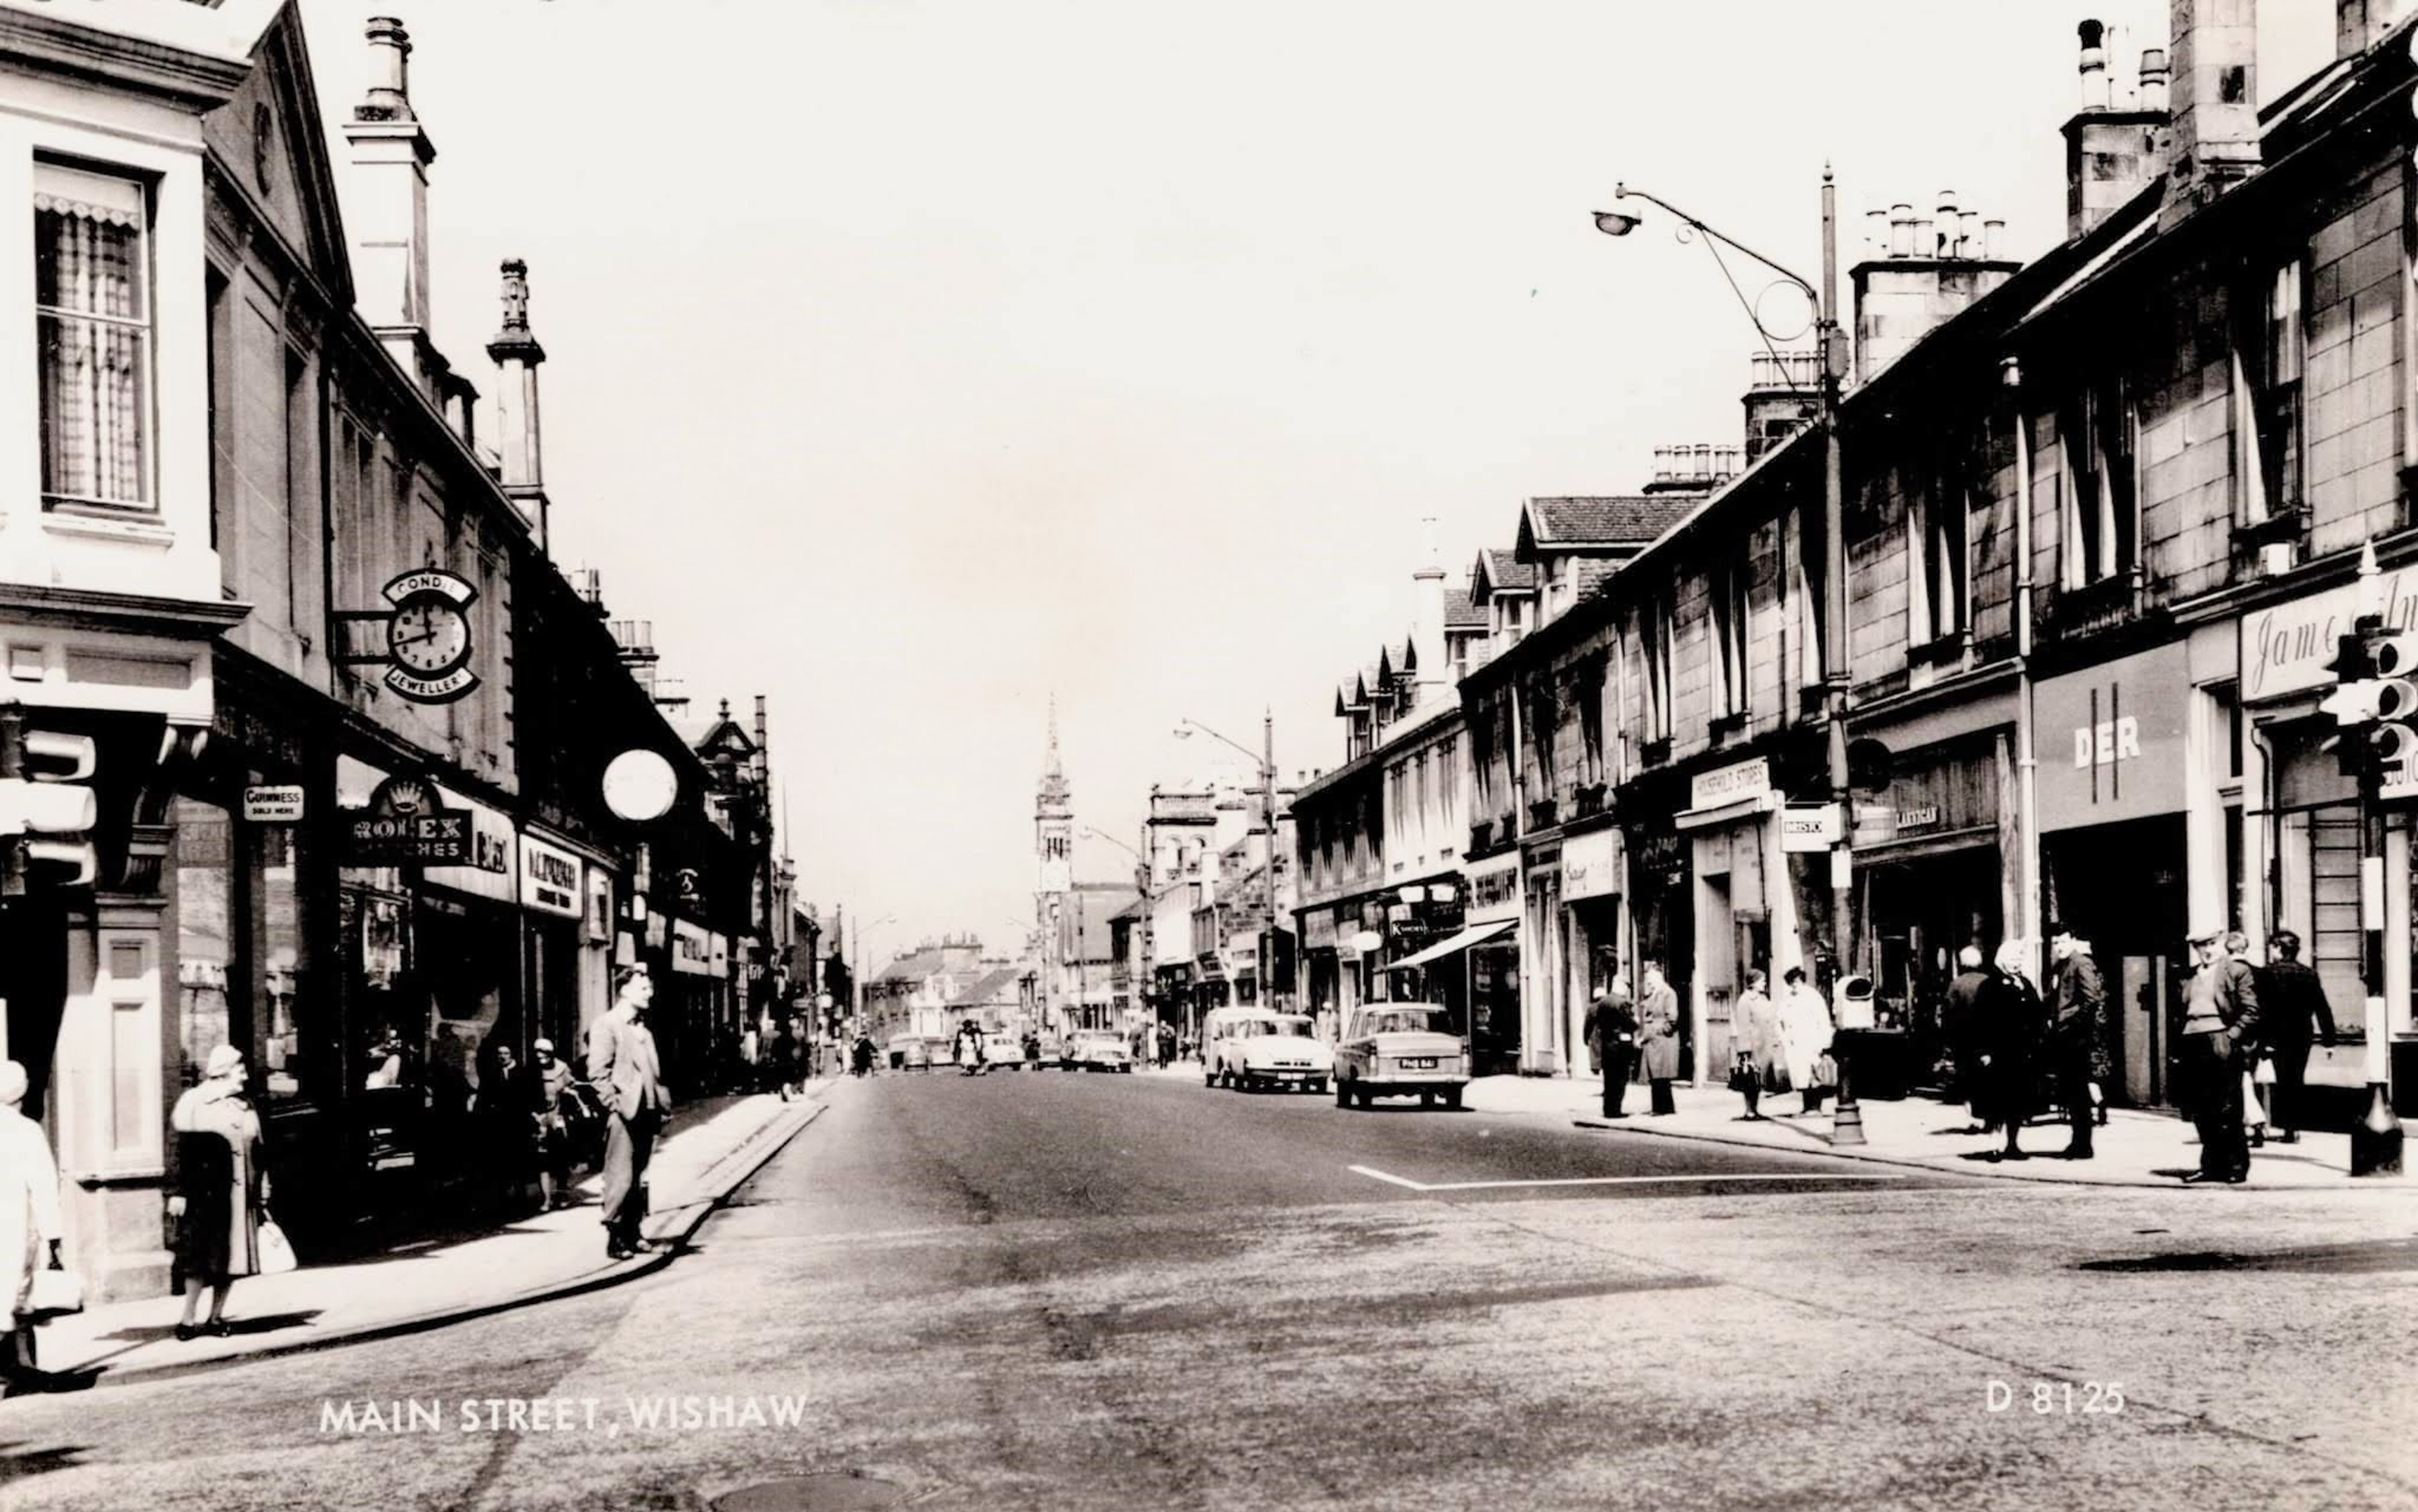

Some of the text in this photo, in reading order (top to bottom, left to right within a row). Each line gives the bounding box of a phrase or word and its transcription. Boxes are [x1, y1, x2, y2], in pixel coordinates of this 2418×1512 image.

[2075, 716, 2141, 770] DER
[247, 790, 300, 804] GUINNESS
[1785, 821, 1826, 834] BRISTO
